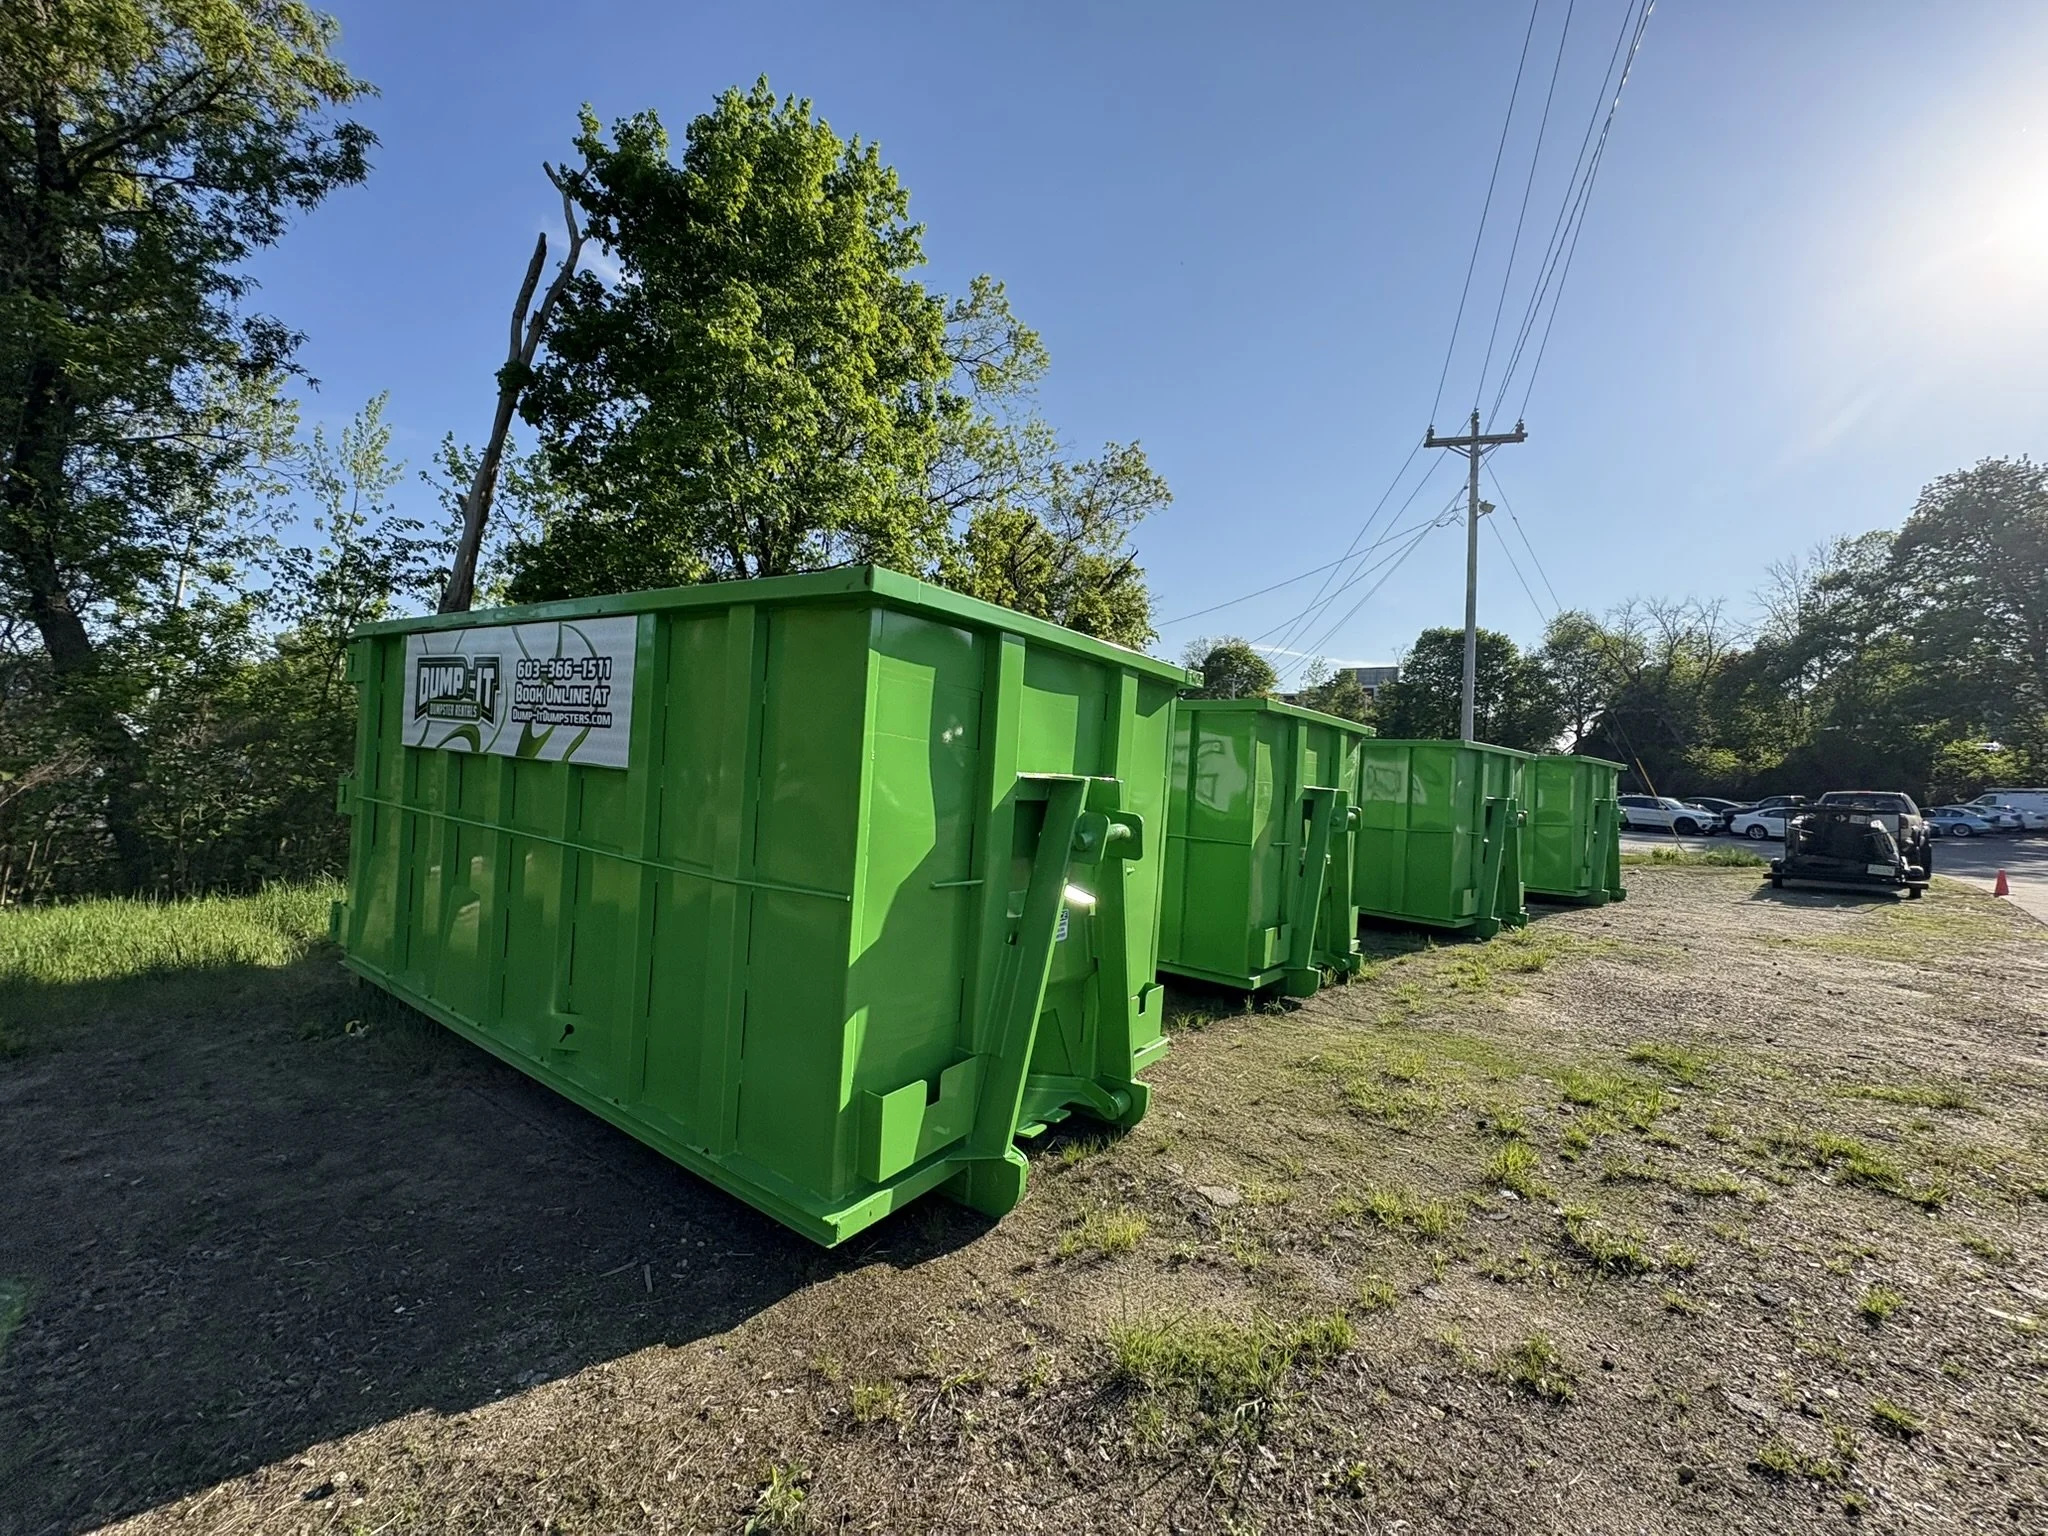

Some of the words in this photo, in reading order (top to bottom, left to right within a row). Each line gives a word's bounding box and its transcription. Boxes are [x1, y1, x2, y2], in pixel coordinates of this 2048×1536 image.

[516, 659, 612, 679] 603-366-1511
[419, 667, 495, 709] DUMP-IT
[430, 703, 454, 716] DUMPSTER
[455, 705, 478, 718] RENTALS
